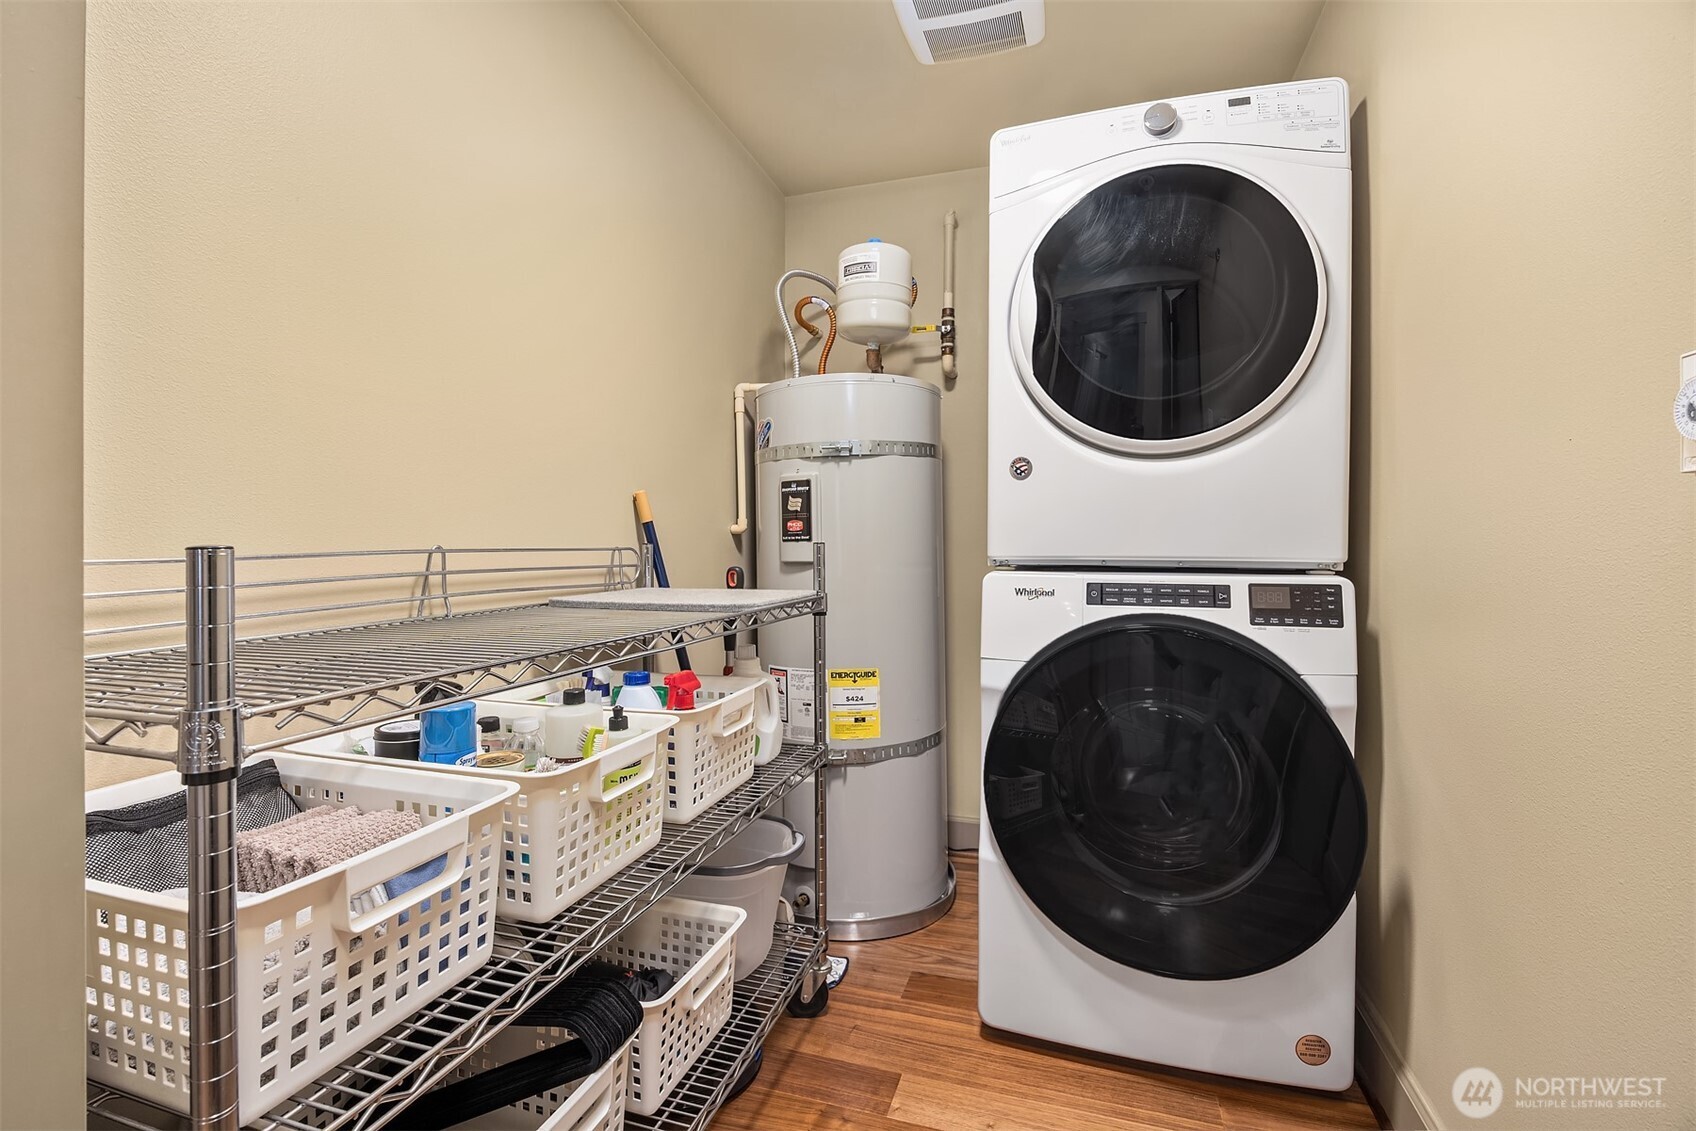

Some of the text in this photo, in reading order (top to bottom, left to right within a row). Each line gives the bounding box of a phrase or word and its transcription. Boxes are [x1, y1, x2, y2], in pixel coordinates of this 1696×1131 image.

[1014, 587, 1055, 600] Whirlpool
[830, 671, 877, 679] ENERGYGUIDE
[845, 695, 864, 703] $424
